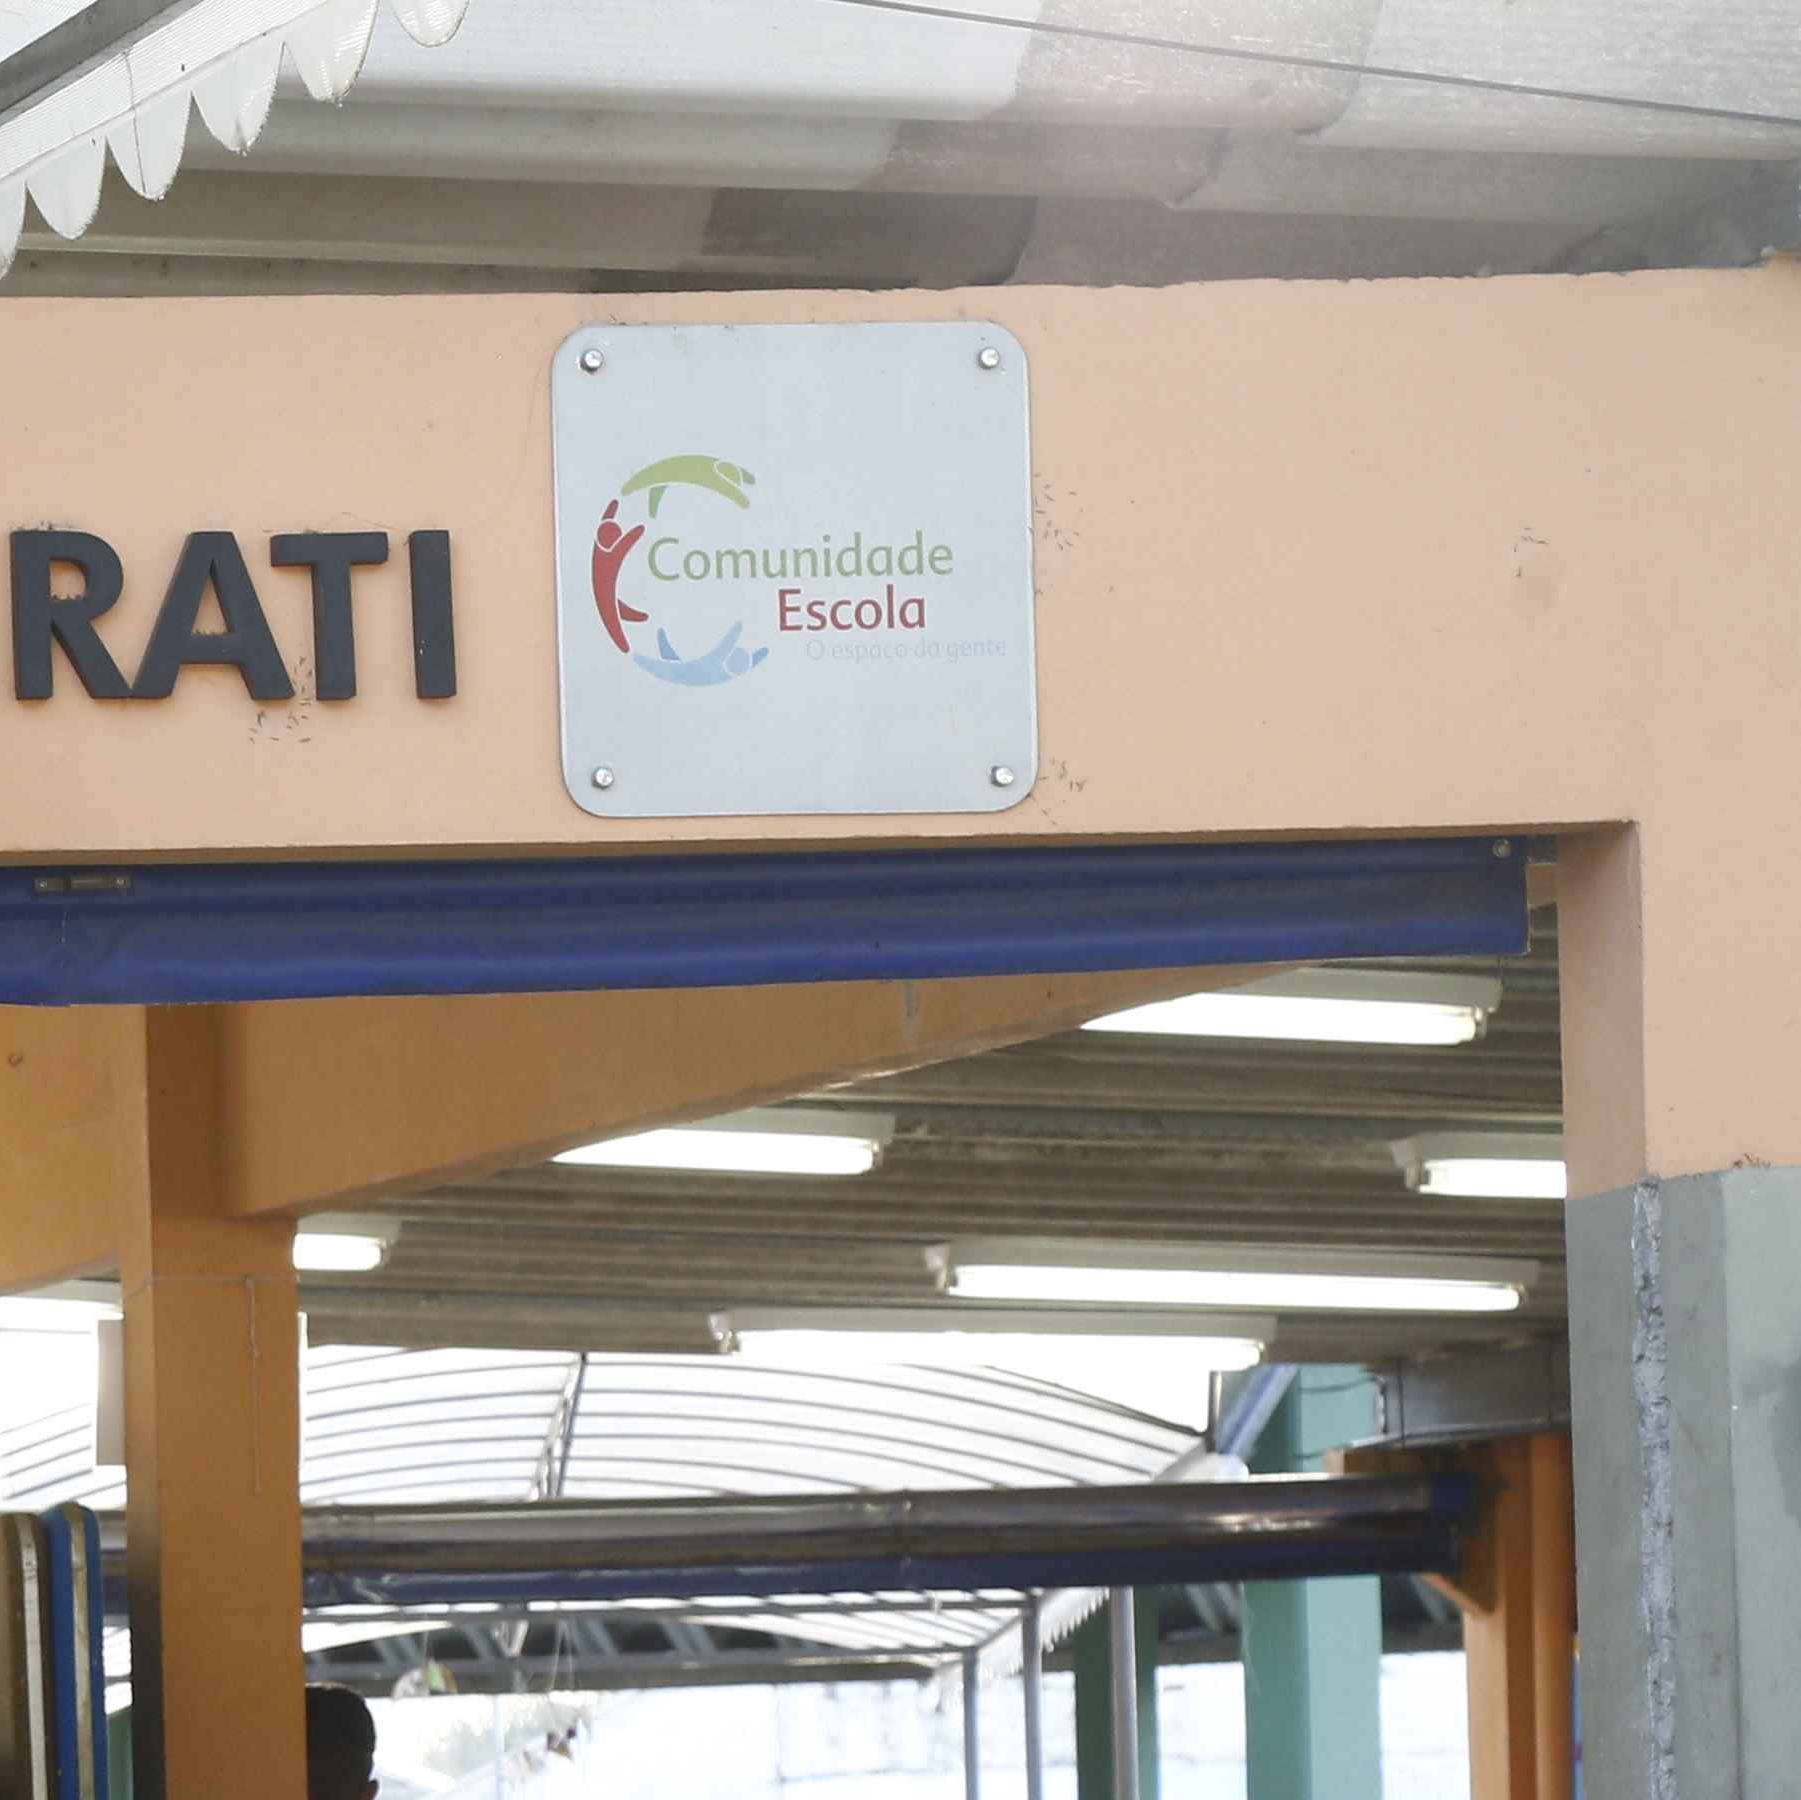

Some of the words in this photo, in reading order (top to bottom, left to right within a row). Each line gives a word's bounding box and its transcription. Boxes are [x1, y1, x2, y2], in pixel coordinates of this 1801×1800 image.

[647, 530, 954, 582] Comunidade
[778, 584, 927, 632] Escola
[806, 638, 825, 661] O
[831, 641, 907, 664] espaço
[913, 635, 940, 659] da
[946, 637, 1007, 663] gente
